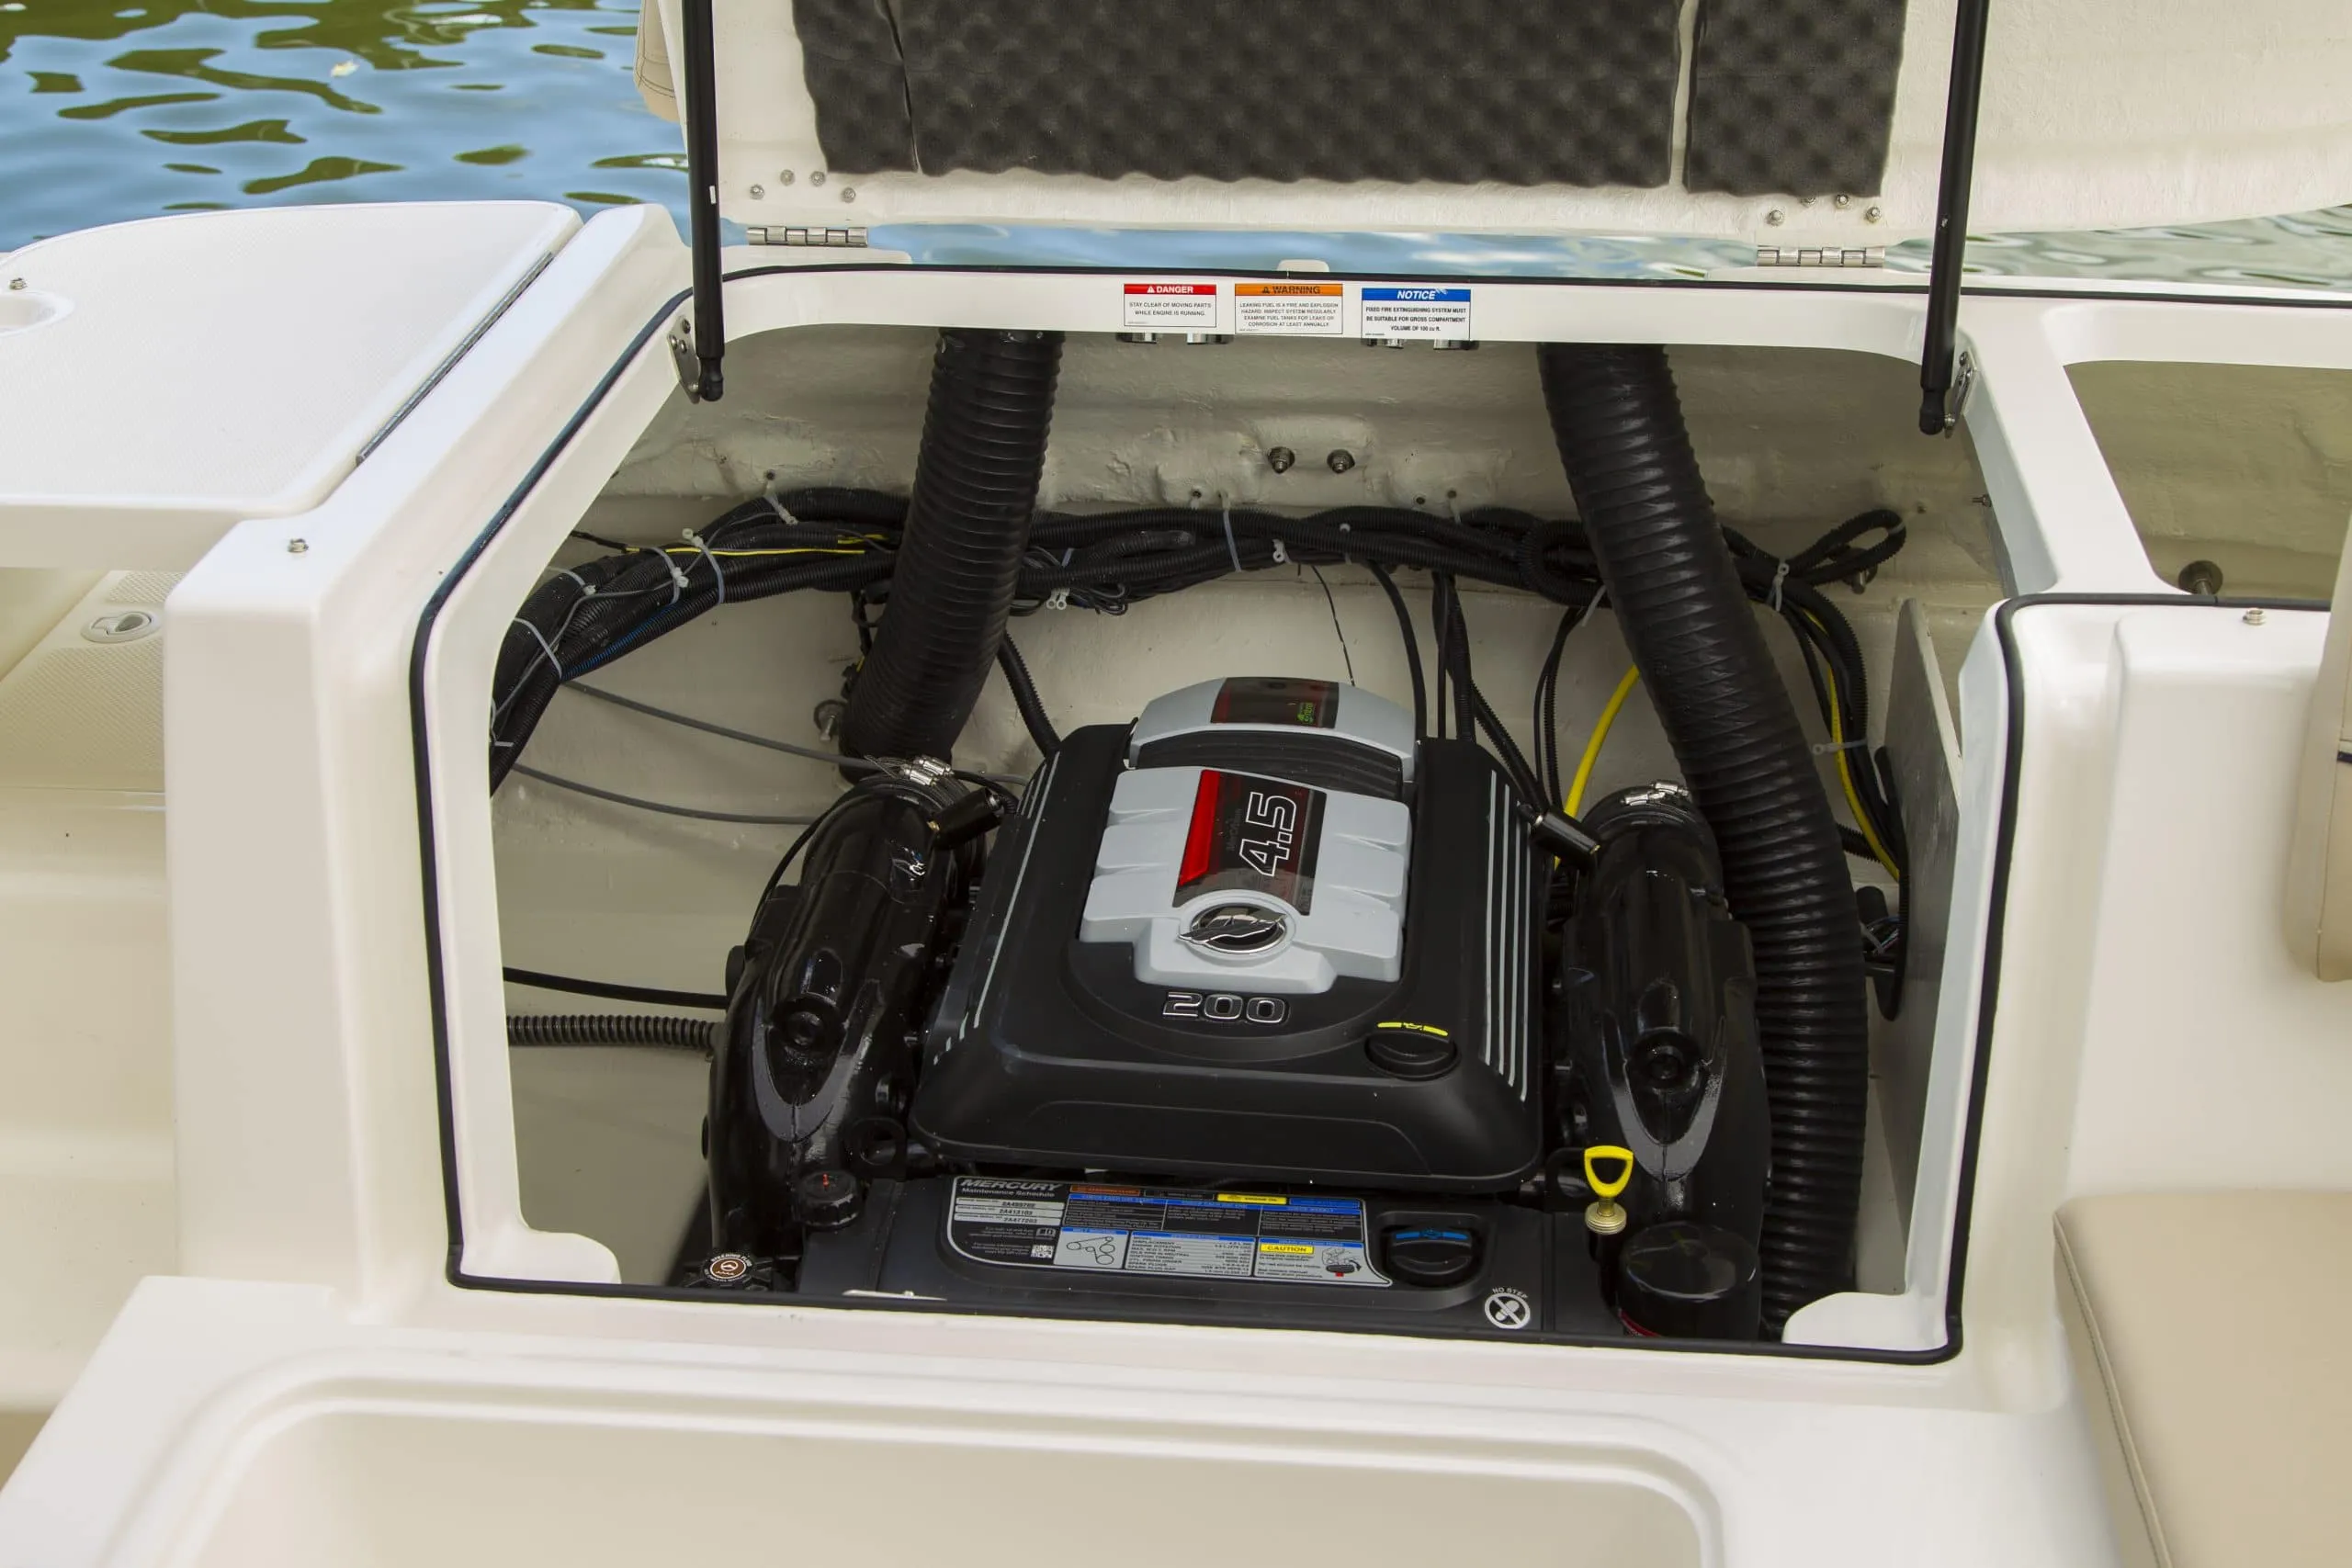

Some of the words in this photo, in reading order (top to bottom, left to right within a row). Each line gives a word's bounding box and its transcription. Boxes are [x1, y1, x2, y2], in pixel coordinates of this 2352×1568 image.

[1156, 286, 1194, 294] DANGER
[1272, 286, 1320, 294] WARNING
[1396, 290, 1436, 299] NOTICE
[1239, 791, 1297, 877] 4.5
[1162, 991, 1286, 1023] 200
[960, 1179, 1063, 1191] MERCURY
[962, 1188, 1014, 1196] Maintenance
[1266, 1245, 1307, 1253] CAUTION
[1507, 1287, 1528, 1299] STEP
